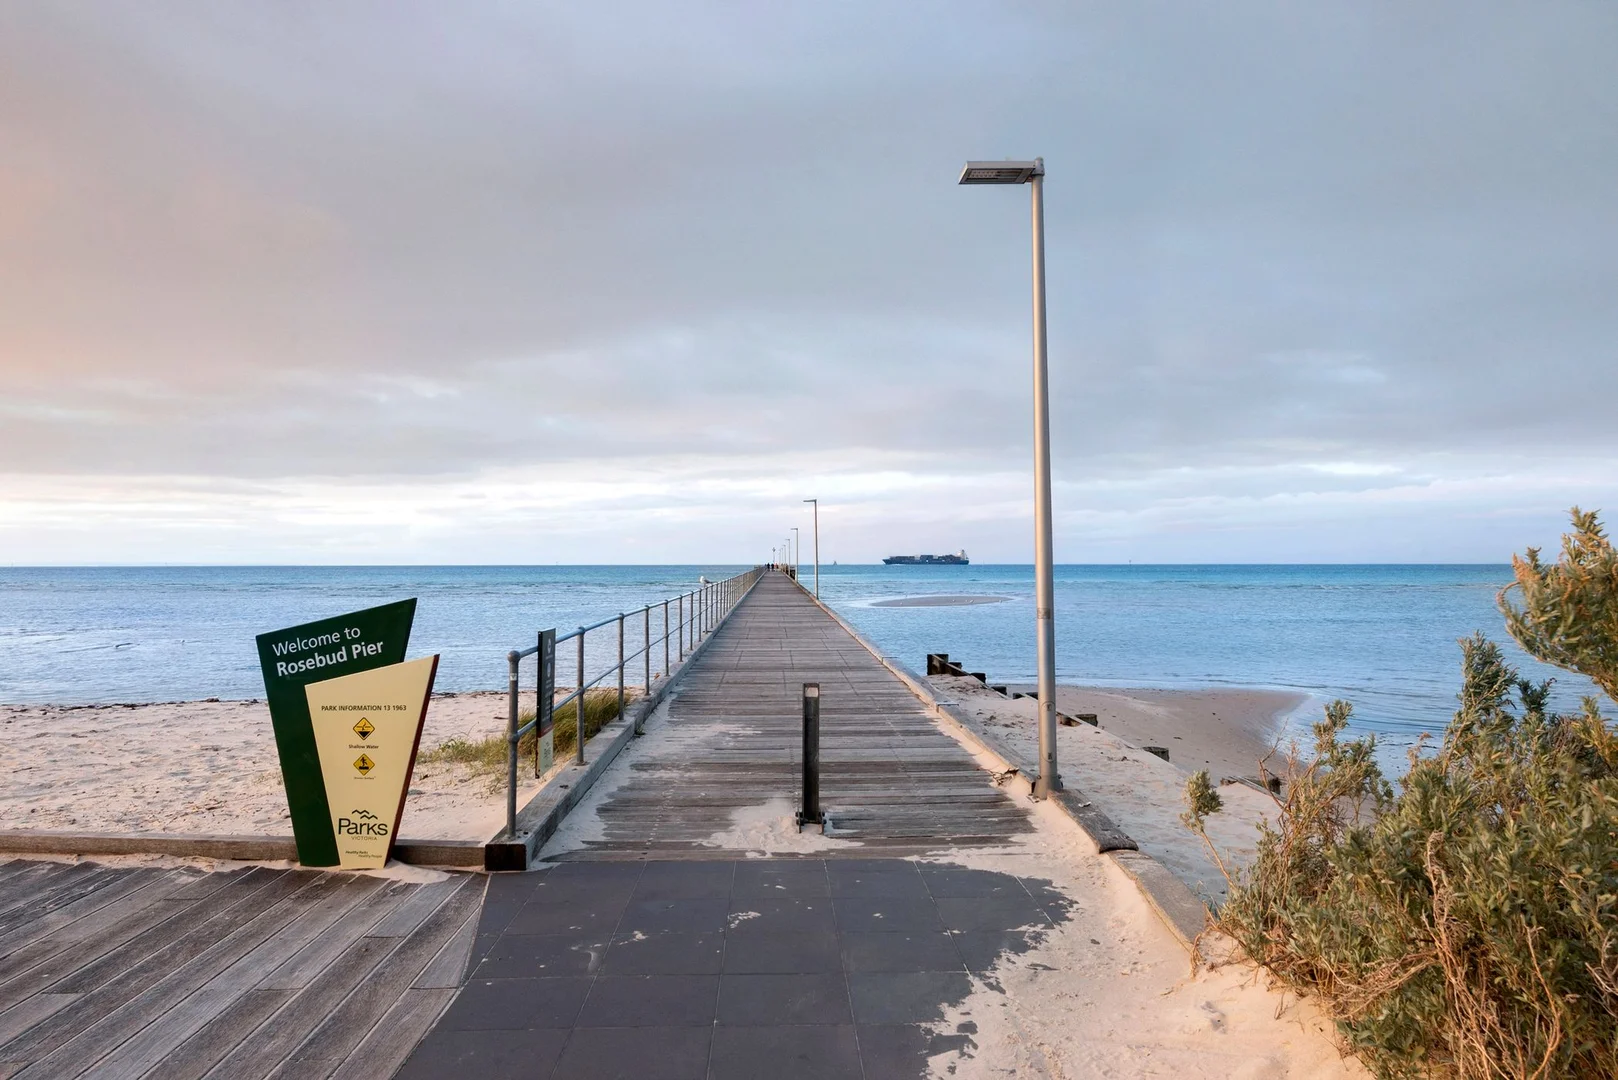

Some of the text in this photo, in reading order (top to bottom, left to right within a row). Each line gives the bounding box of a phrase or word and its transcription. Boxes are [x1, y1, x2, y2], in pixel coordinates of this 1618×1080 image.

[272, 627, 361, 656] Welcome to
[276, 641, 384, 677] Rosebud Pier
[338, 818, 388, 836] Parks
